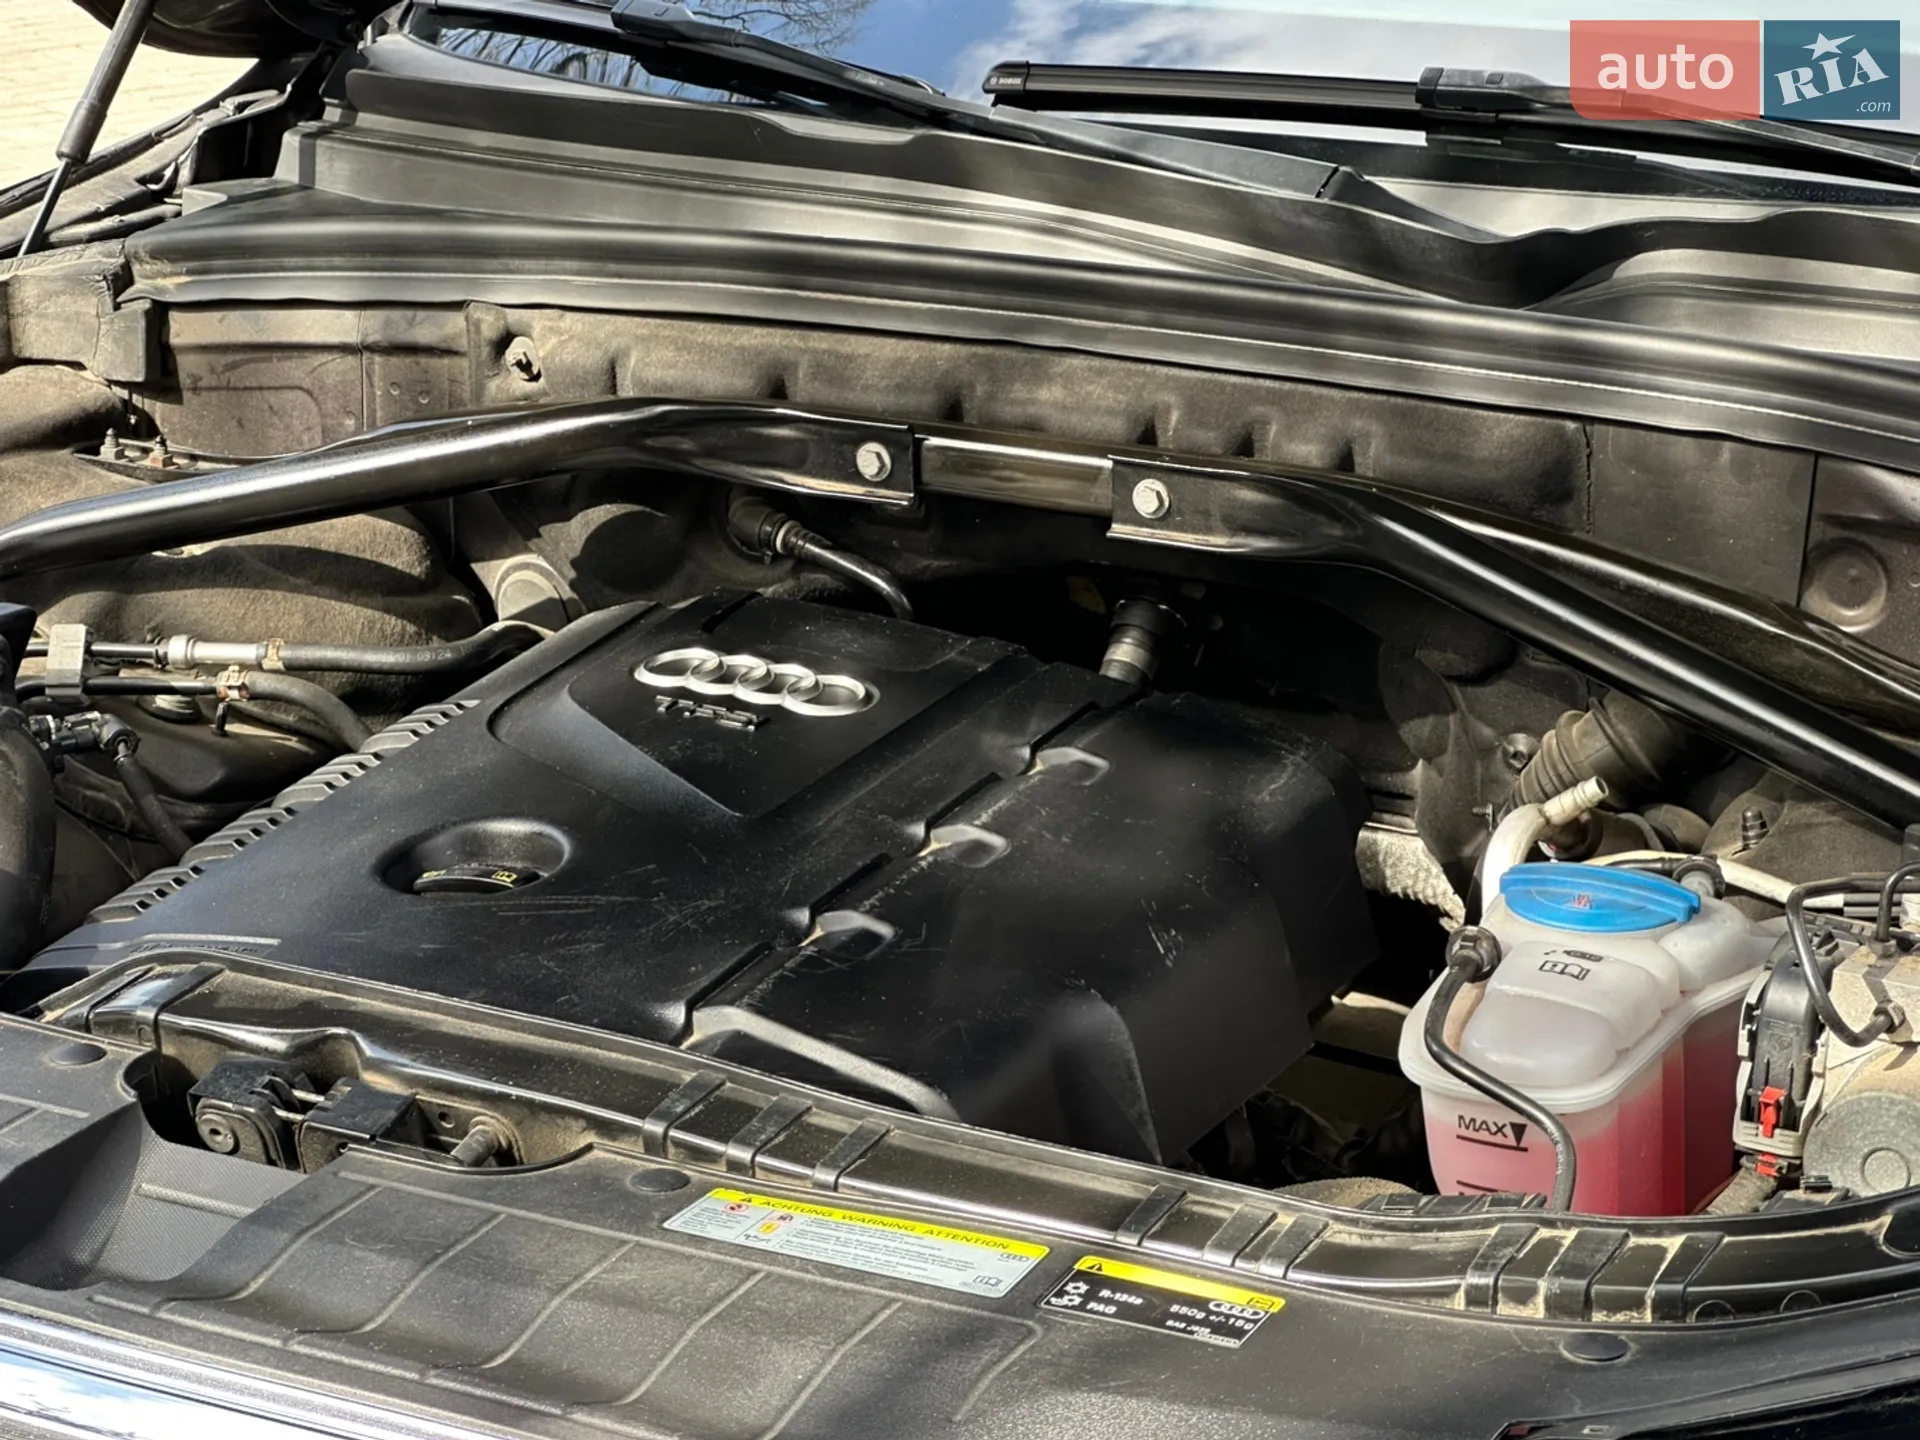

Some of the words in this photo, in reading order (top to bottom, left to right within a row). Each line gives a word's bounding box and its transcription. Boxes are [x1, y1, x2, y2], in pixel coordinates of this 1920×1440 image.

[1458, 1114, 1508, 1139] MAX
[759, 1200, 834, 1219] ACHTUNG
[840, 1212, 916, 1233] WARNING
[924, 1228, 1011, 1250] ATTENTION
